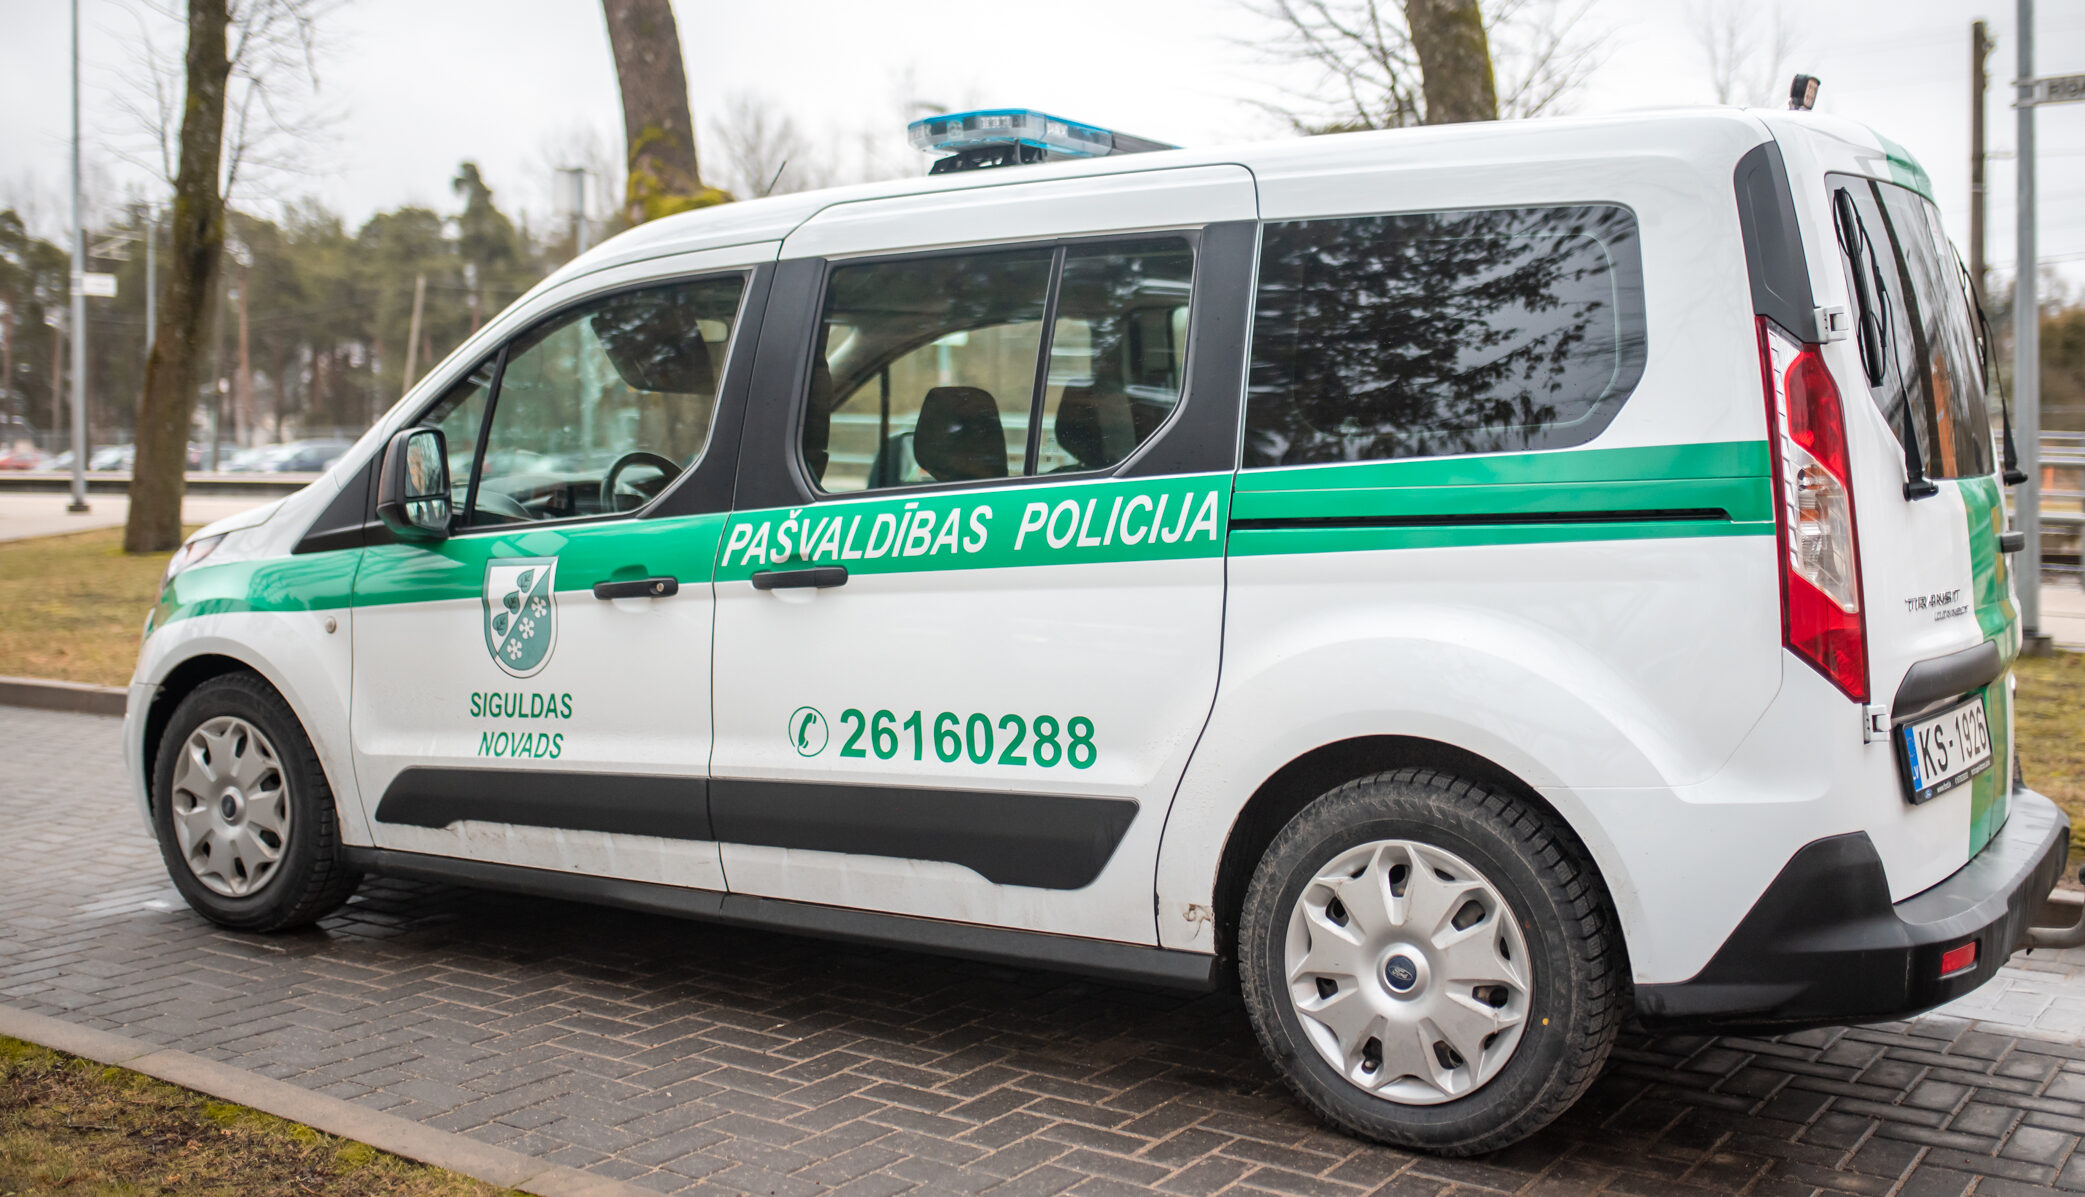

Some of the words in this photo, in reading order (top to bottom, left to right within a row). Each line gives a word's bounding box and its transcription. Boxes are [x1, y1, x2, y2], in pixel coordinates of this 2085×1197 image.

[721, 502, 993, 567] PAŠVALDĪBAS
[1013, 490, 1220, 551] POLICIJA
[1904, 588, 1961, 612] TRANSIT
[469, 692, 573, 719] SIGULDAS
[477, 731, 564, 760] NOVADS
[839, 708, 1097, 770] 26160288
[1918, 706, 1987, 780] KS-1926
